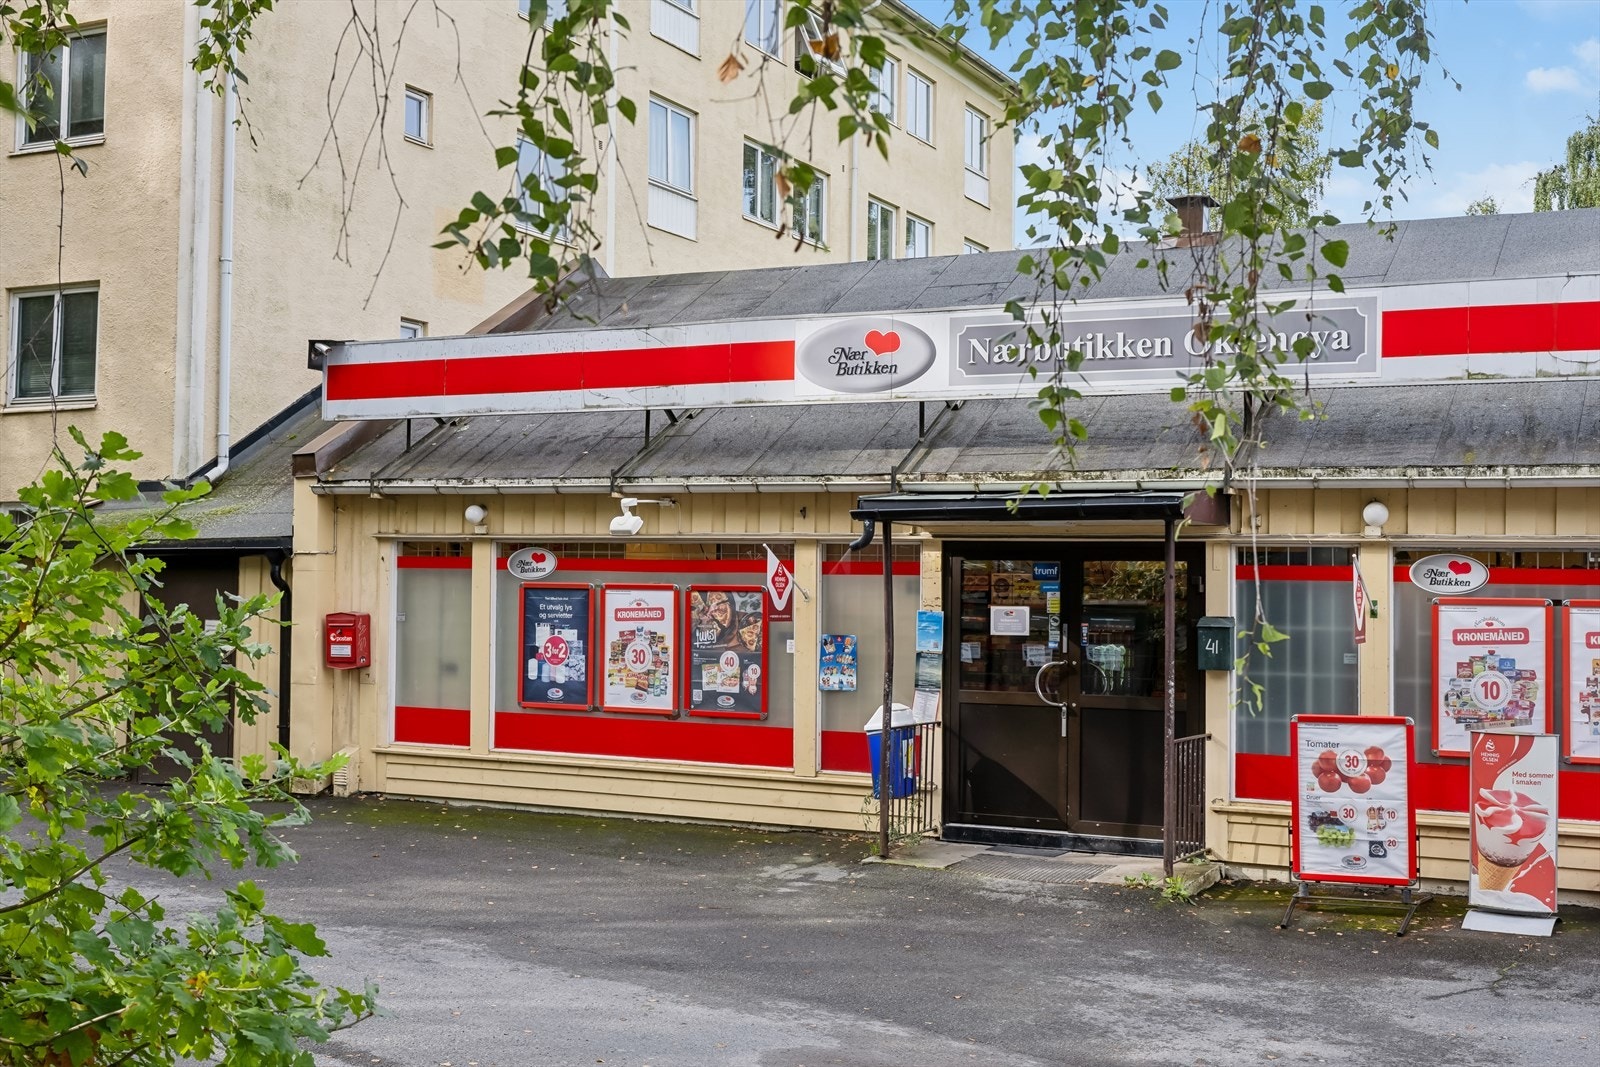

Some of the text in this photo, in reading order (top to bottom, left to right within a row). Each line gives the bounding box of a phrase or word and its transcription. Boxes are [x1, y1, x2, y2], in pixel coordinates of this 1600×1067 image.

[967, 327, 1350, 364] Nærbutikken Okenya
[828, 347, 868, 364] Nær
[835, 361, 898, 376] Butikken
[516, 559, 533, 568] Nær
[520, 566, 546, 574] Butikken
[1033, 566, 1058, 575] trumf
[1423, 568, 1450, 578] Nær
[1429, 577, 1471, 587] Butikken
[546, 603, 563, 611] utvalg
[564, 603, 573, 611] lys
[538, 612, 547, 620] og
[617, 608, 662, 619] KRONEMÅNED
[1456, 629, 1525, 642] KRONEMÅNED
[1205, 638, 1219, 654] 41
[631, 648, 646, 665] 30
[724, 656, 735, 668] 40
[751, 667, 758, 675] 10
[1480, 680, 1501, 700] 10
[1305, 739, 1340, 749] Tomater
[1344, 755, 1359, 769] 30
[1343, 808, 1355, 819] 30
[1386, 810, 1396, 819] 10
[1387, 839, 1397, 848] 20
